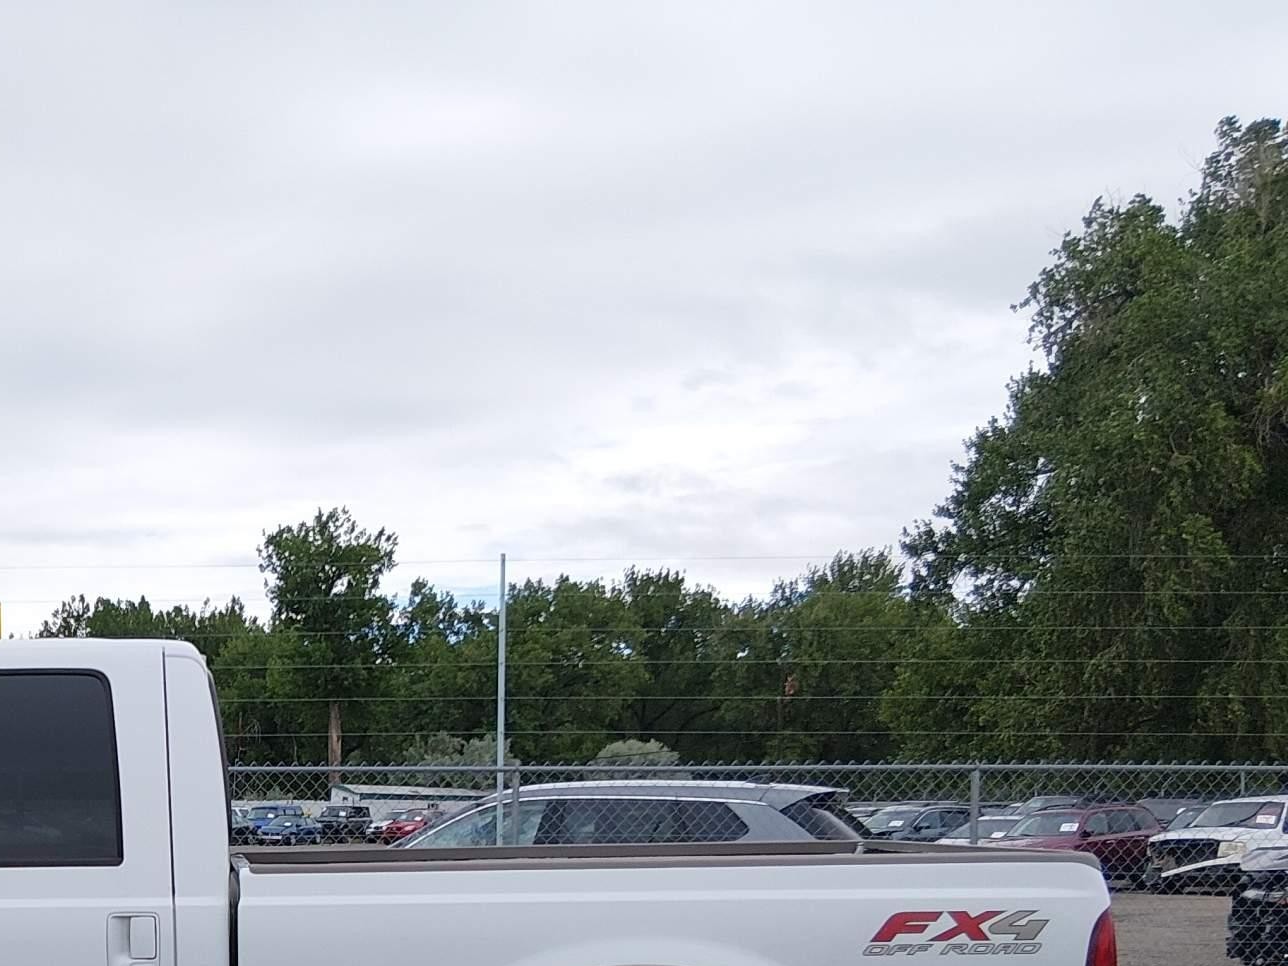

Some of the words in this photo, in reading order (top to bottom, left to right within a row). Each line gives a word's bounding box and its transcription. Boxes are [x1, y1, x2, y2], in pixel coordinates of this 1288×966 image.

[870, 910, 1050, 942] FX4
[862, 943, 934, 956] OFF
[939, 942, 1043, 955] ROAD
